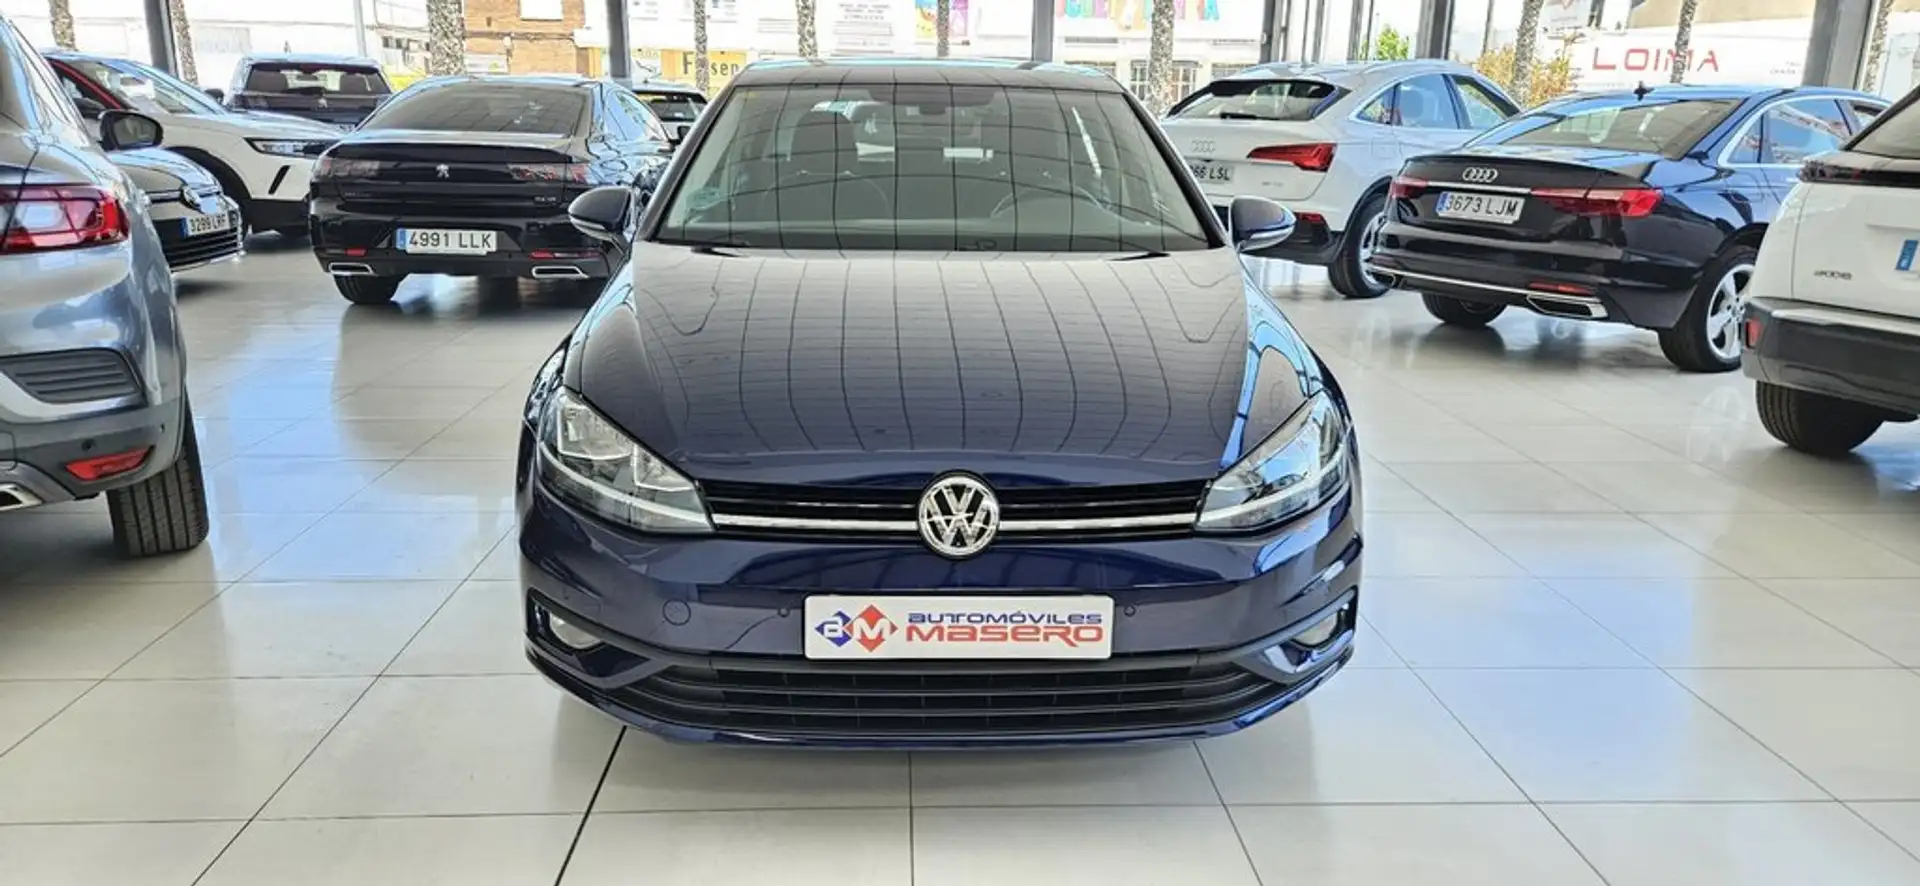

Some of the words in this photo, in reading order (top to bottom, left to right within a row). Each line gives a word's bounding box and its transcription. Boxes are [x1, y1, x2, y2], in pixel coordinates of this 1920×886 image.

[682, 51, 739, 76] Fsen
[1209, 166, 1231, 181] LSL
[1447, 194, 1482, 213] 3673
[1485, 198, 1518, 216] LJM
[408, 231, 450, 248] 4991
[458, 232, 492, 249] LLK
